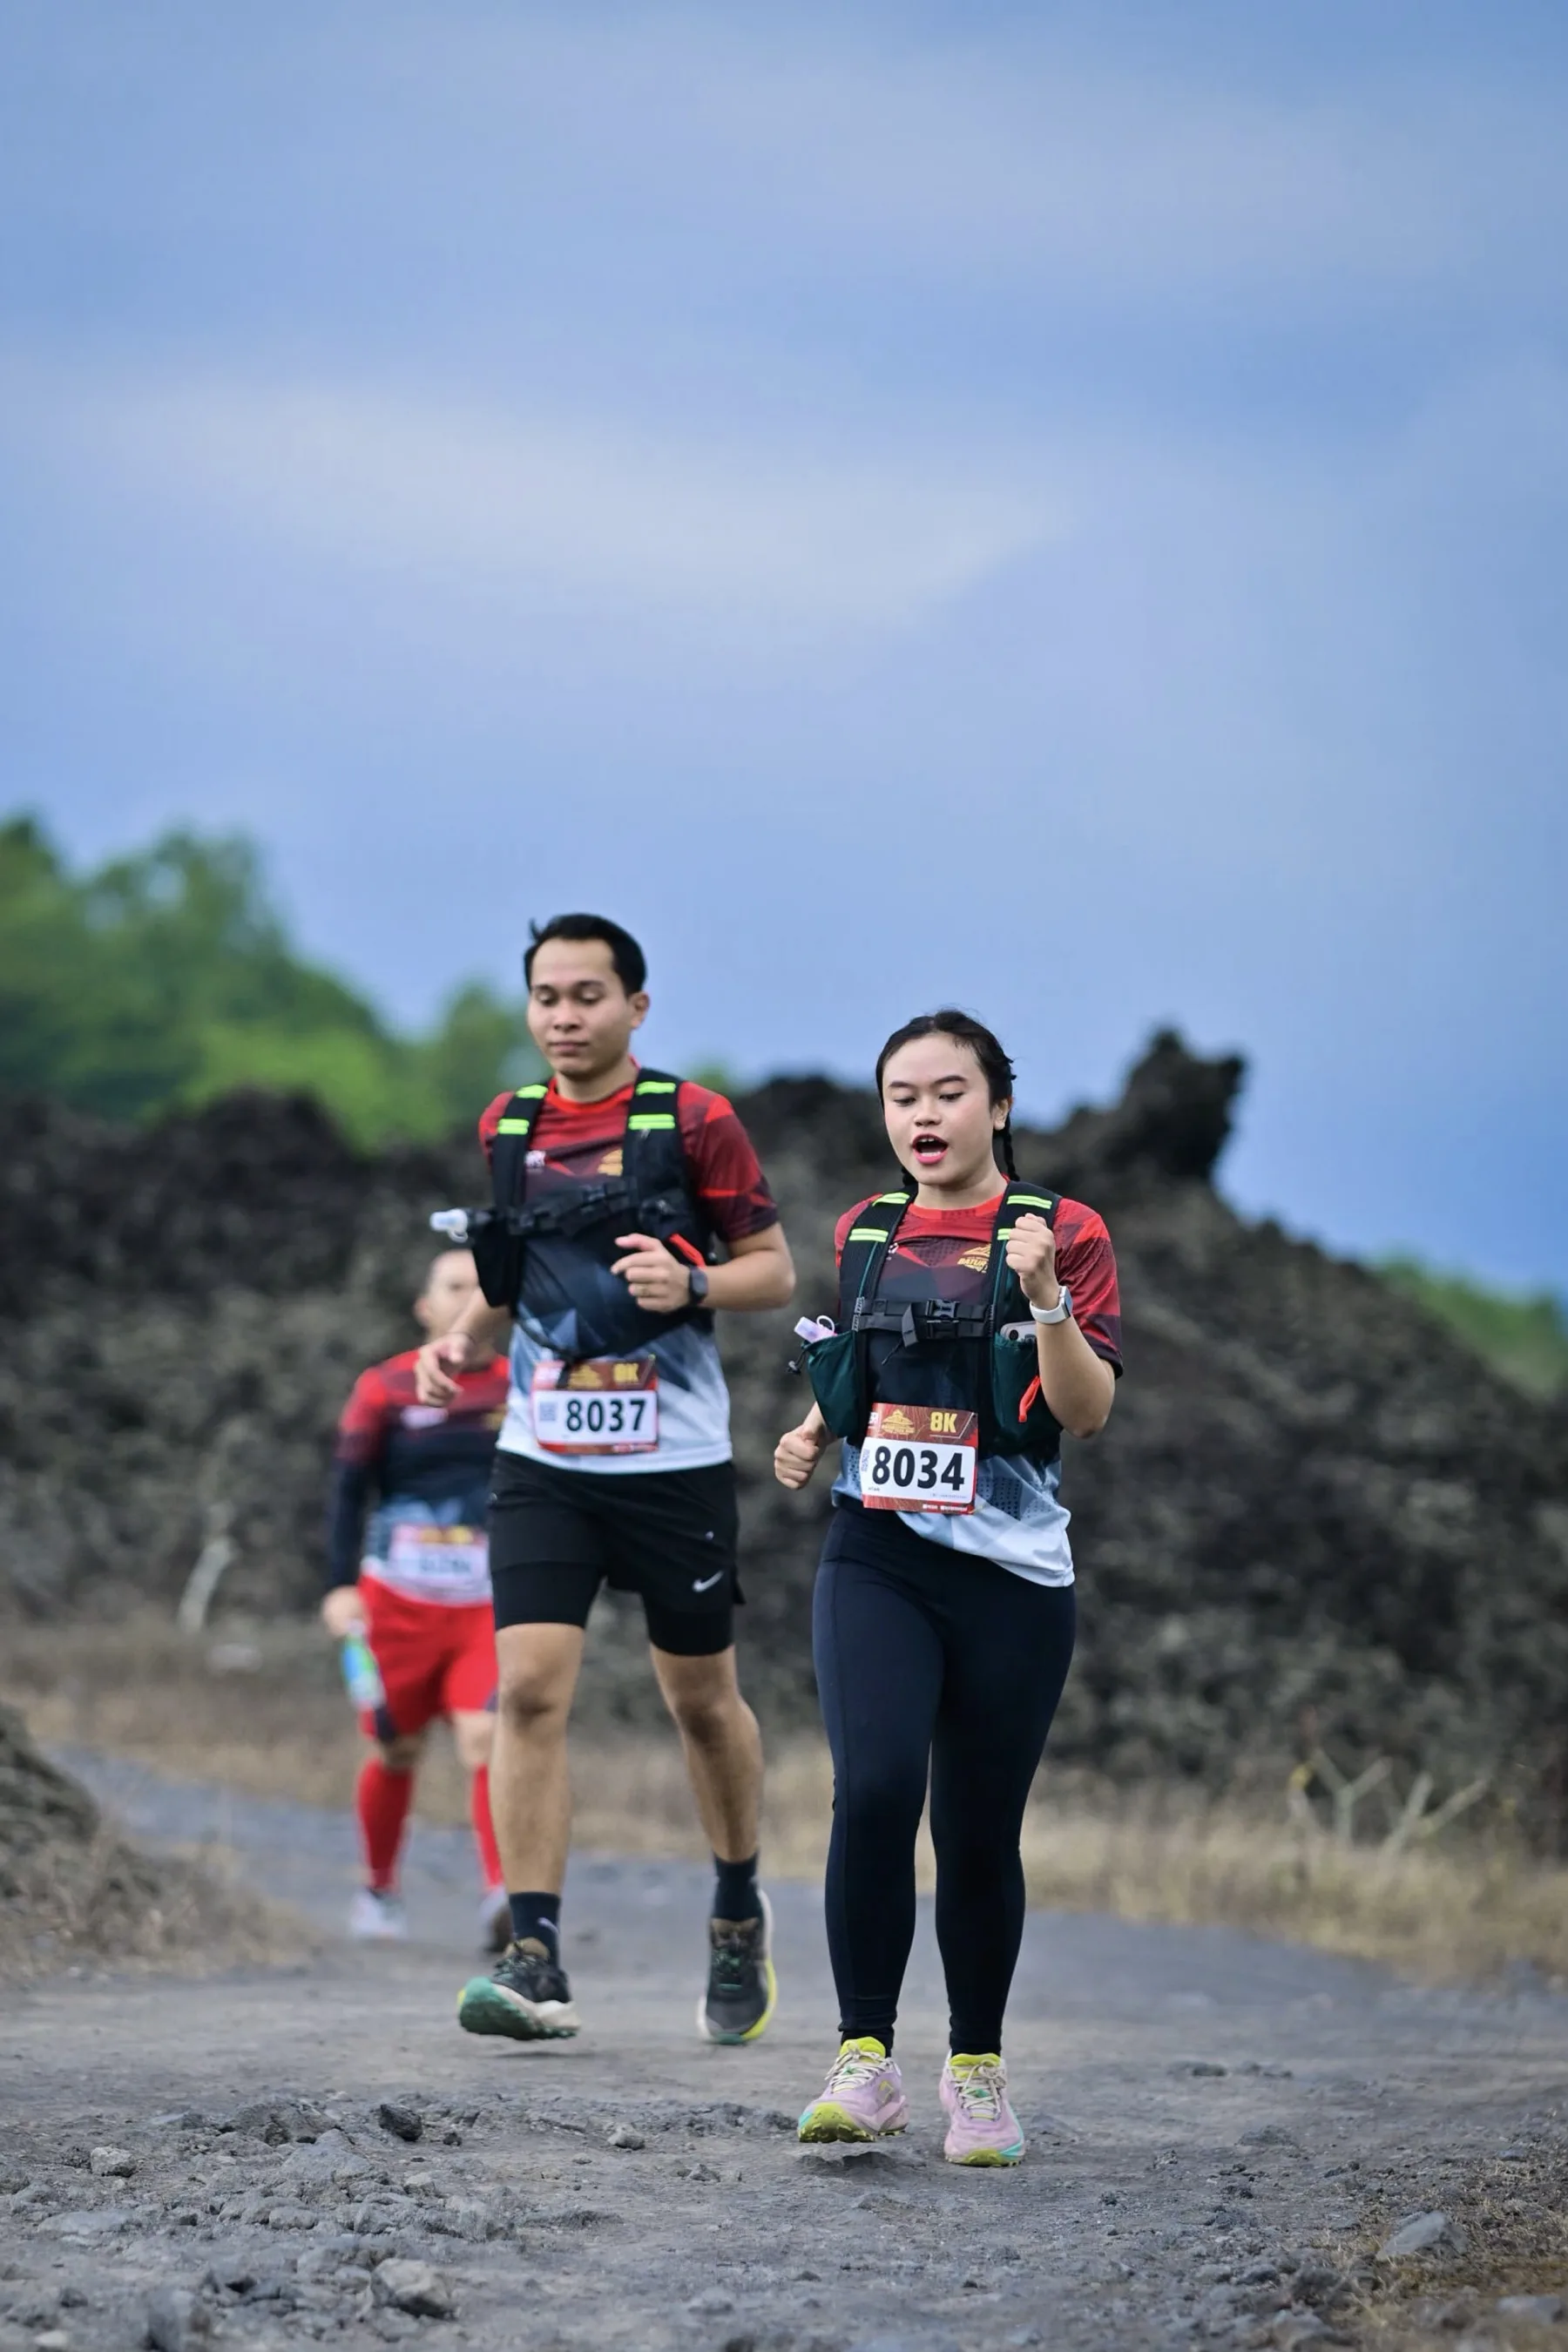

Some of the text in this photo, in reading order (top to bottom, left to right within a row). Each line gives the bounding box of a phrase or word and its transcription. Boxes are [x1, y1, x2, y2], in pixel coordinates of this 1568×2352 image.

[565, 1398, 646, 1433] 8037
[929, 1411, 959, 1434] 8K
[872, 1445, 965, 1491] 8034
